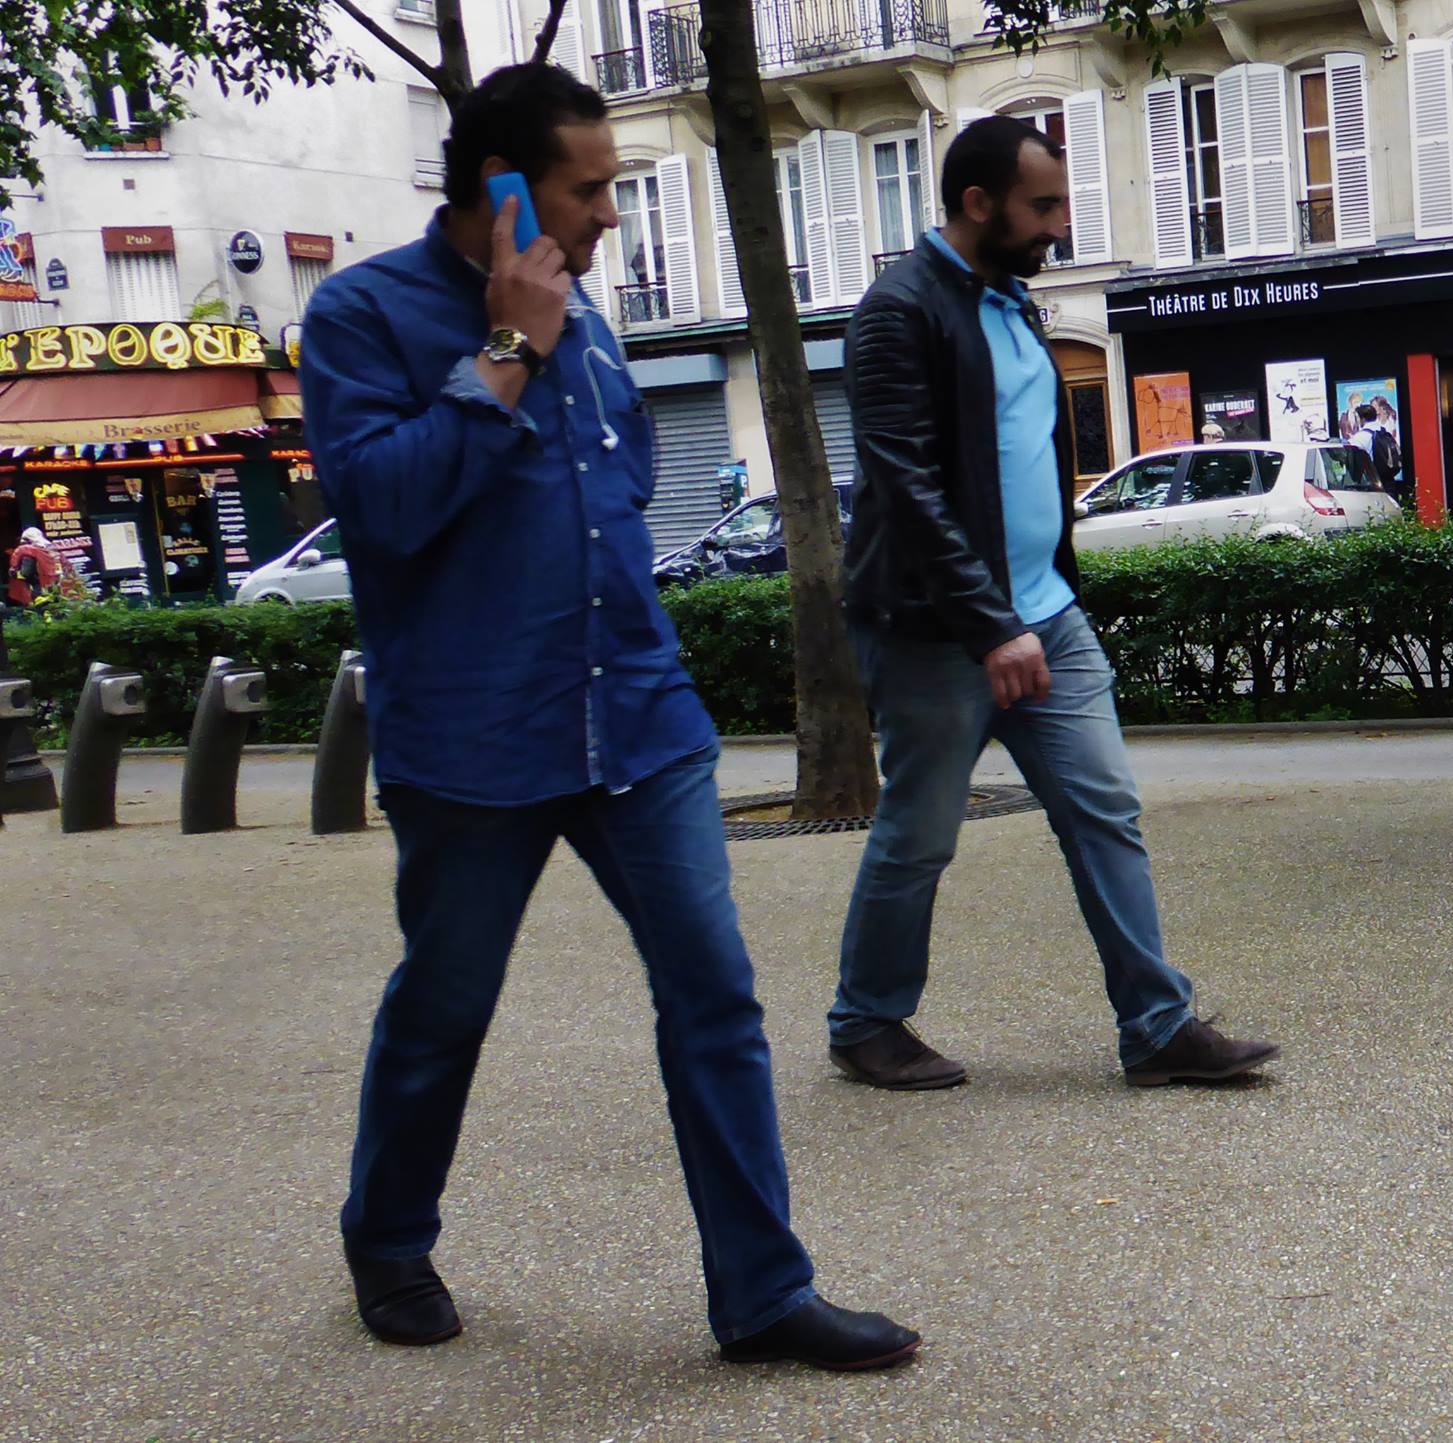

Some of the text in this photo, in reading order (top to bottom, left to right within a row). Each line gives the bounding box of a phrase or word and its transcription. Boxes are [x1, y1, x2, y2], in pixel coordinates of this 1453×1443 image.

[126, 234, 152, 245] Pub
[1149, 282, 1319, 316] THÉÂTRE DE DIX HEURES
[103, 419, 201, 438] Brasserie
